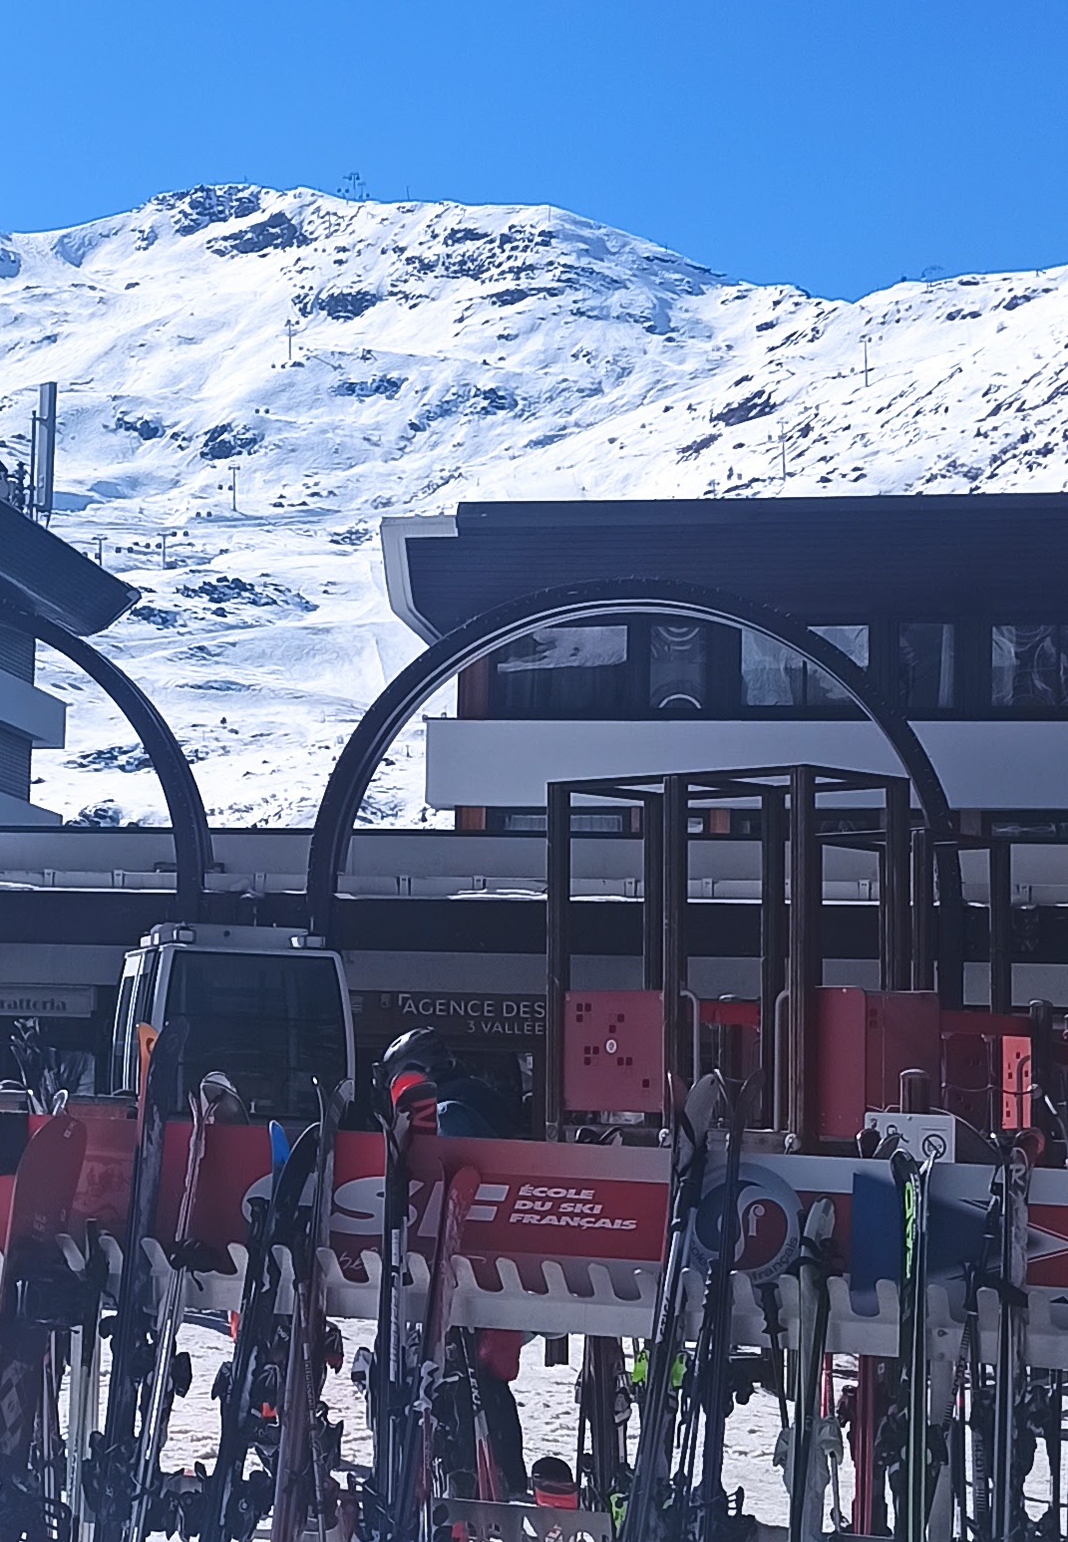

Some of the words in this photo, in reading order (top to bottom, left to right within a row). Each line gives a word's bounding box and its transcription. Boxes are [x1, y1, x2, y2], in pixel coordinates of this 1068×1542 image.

[402, 998, 495, 1017] AGENCE
[502, 1001, 546, 1018] DES
[467, 1020, 476, 1033] 3
[518, 1184, 595, 1200] ÉCOLE
[513, 1200, 553, 1213] DU
[559, 1202, 603, 1215] SKI
[508, 1213, 638, 1231] FRANÇAIS
